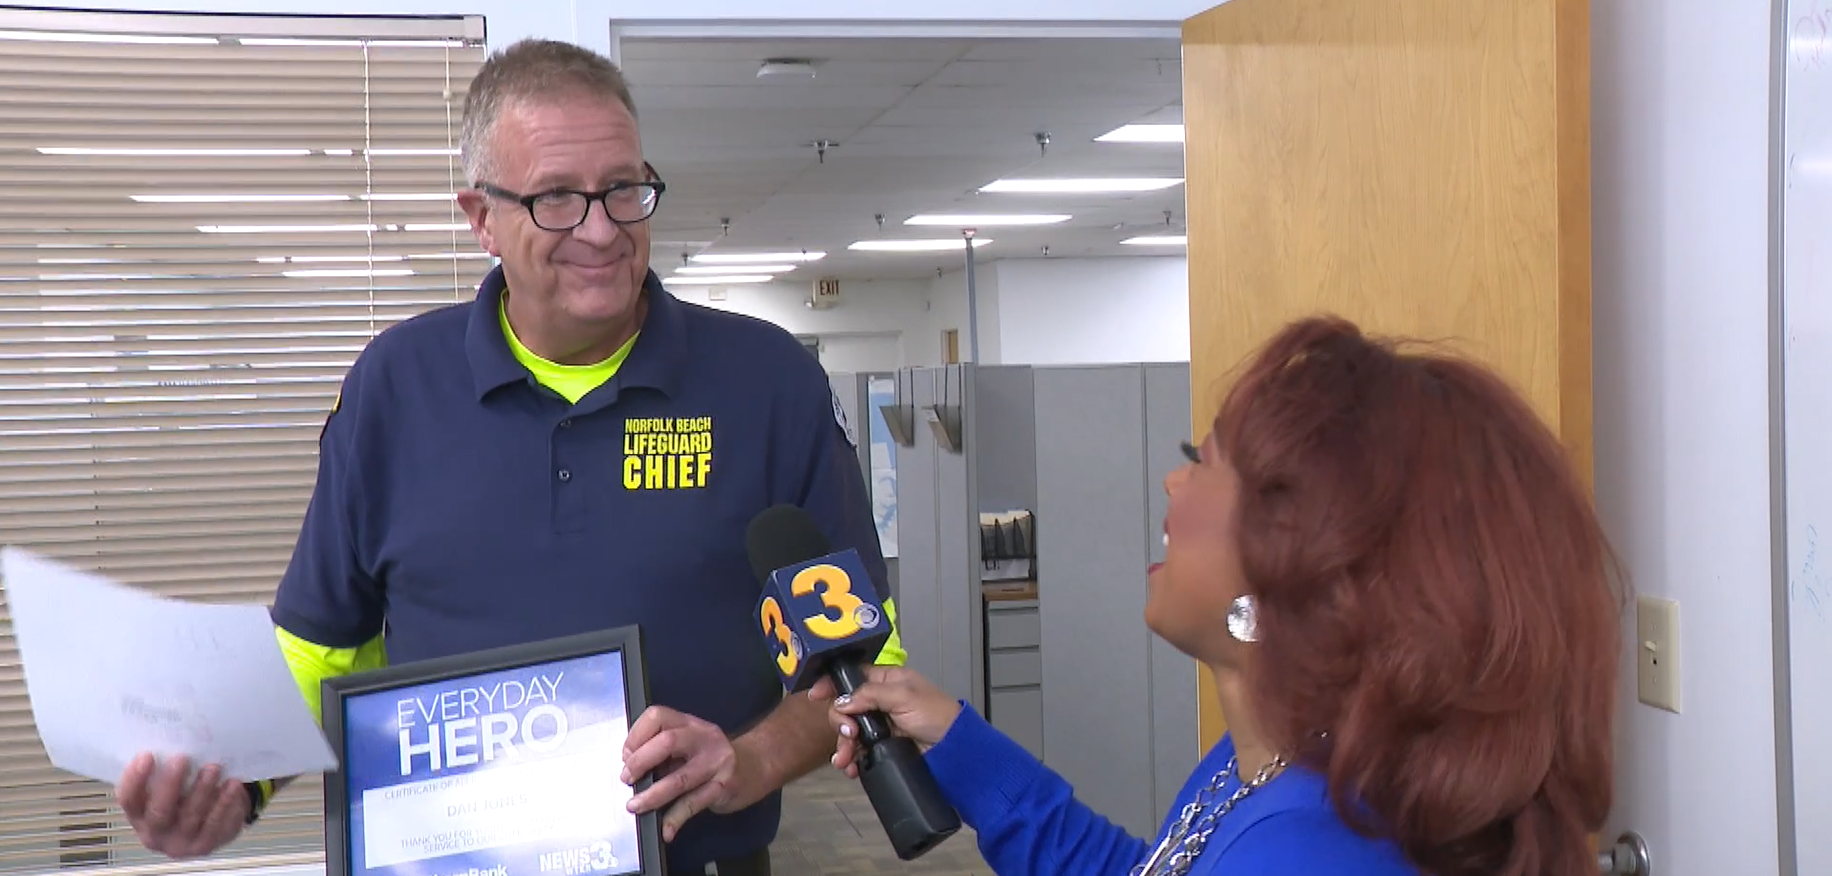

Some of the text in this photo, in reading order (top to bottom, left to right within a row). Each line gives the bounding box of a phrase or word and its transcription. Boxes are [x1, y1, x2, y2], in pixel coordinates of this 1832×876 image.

[819, 279, 839, 296] EXIT
[625, 416, 712, 433] NORFOLK BEACH
[624, 432, 712, 455] LIFEGUARD
[623, 453, 712, 490] CHIEF
[791, 564, 864, 640] 3
[760, 595, 798, 677] 3
[397, 671, 565, 729] EVERYDAY
[399, 703, 569, 776] HERO
[384, 781, 439, 800] CERTIFICATE
[446, 793, 528, 818] DAN JONES
[400, 834, 431, 849] THANK
[432, 830, 452, 843] YOU
[423, 838, 459, 854] SERVICE
[539, 840, 612, 873] NEWS 3
